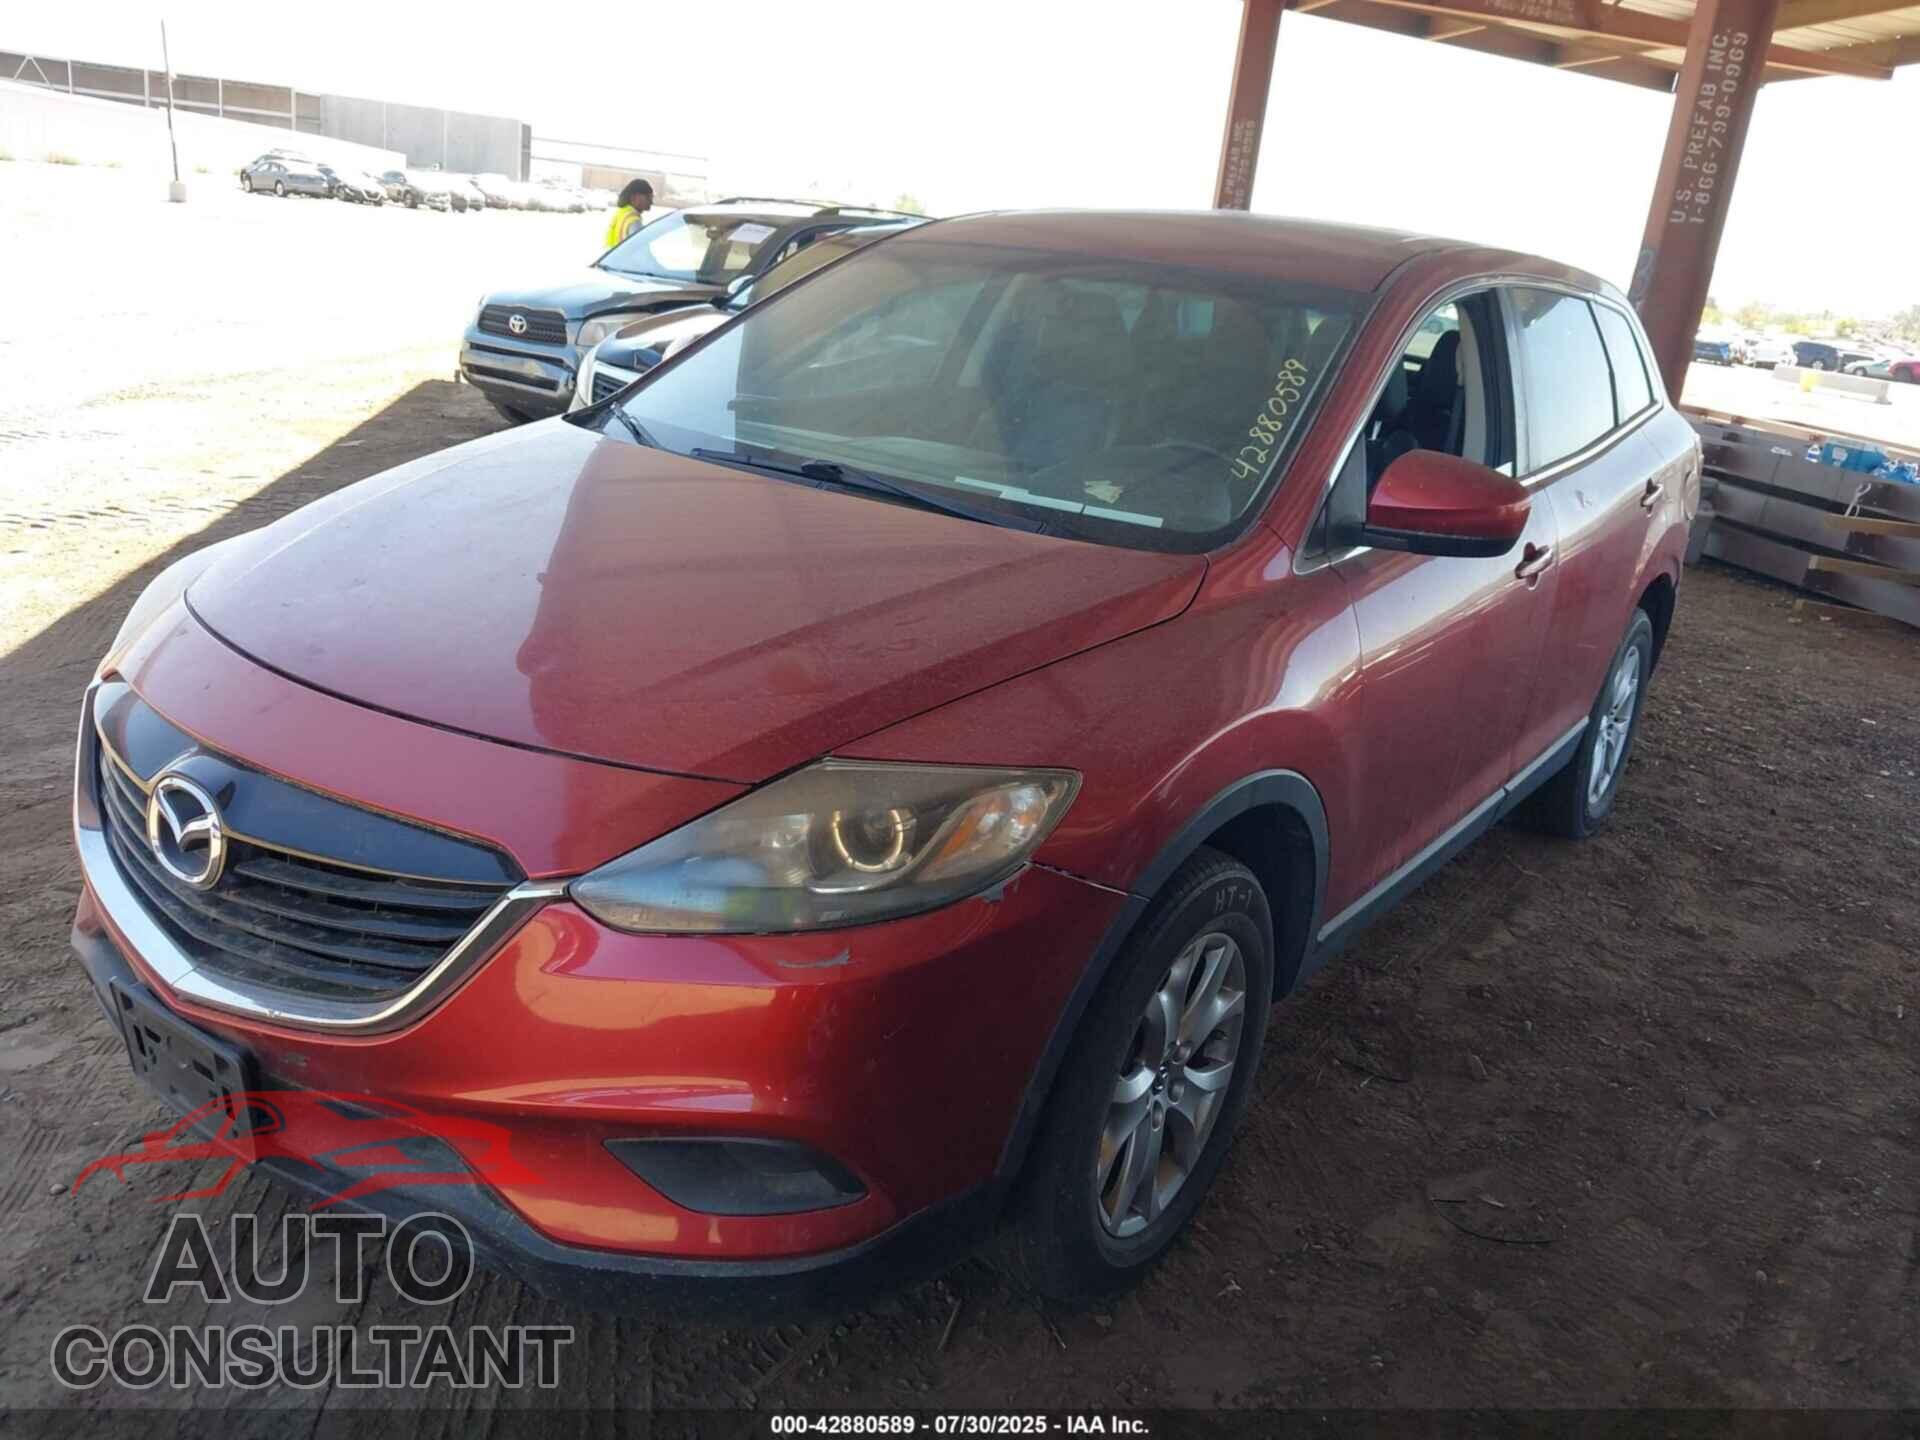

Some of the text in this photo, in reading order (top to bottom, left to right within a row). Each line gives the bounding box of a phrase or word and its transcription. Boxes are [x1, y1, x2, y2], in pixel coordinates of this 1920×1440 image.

[1669, 28, 1732, 224] U.S. PREFAB INC.
[1688, 31, 1749, 224] 1-866-799-0969
[1230, 358, 1308, 478] 42880589
